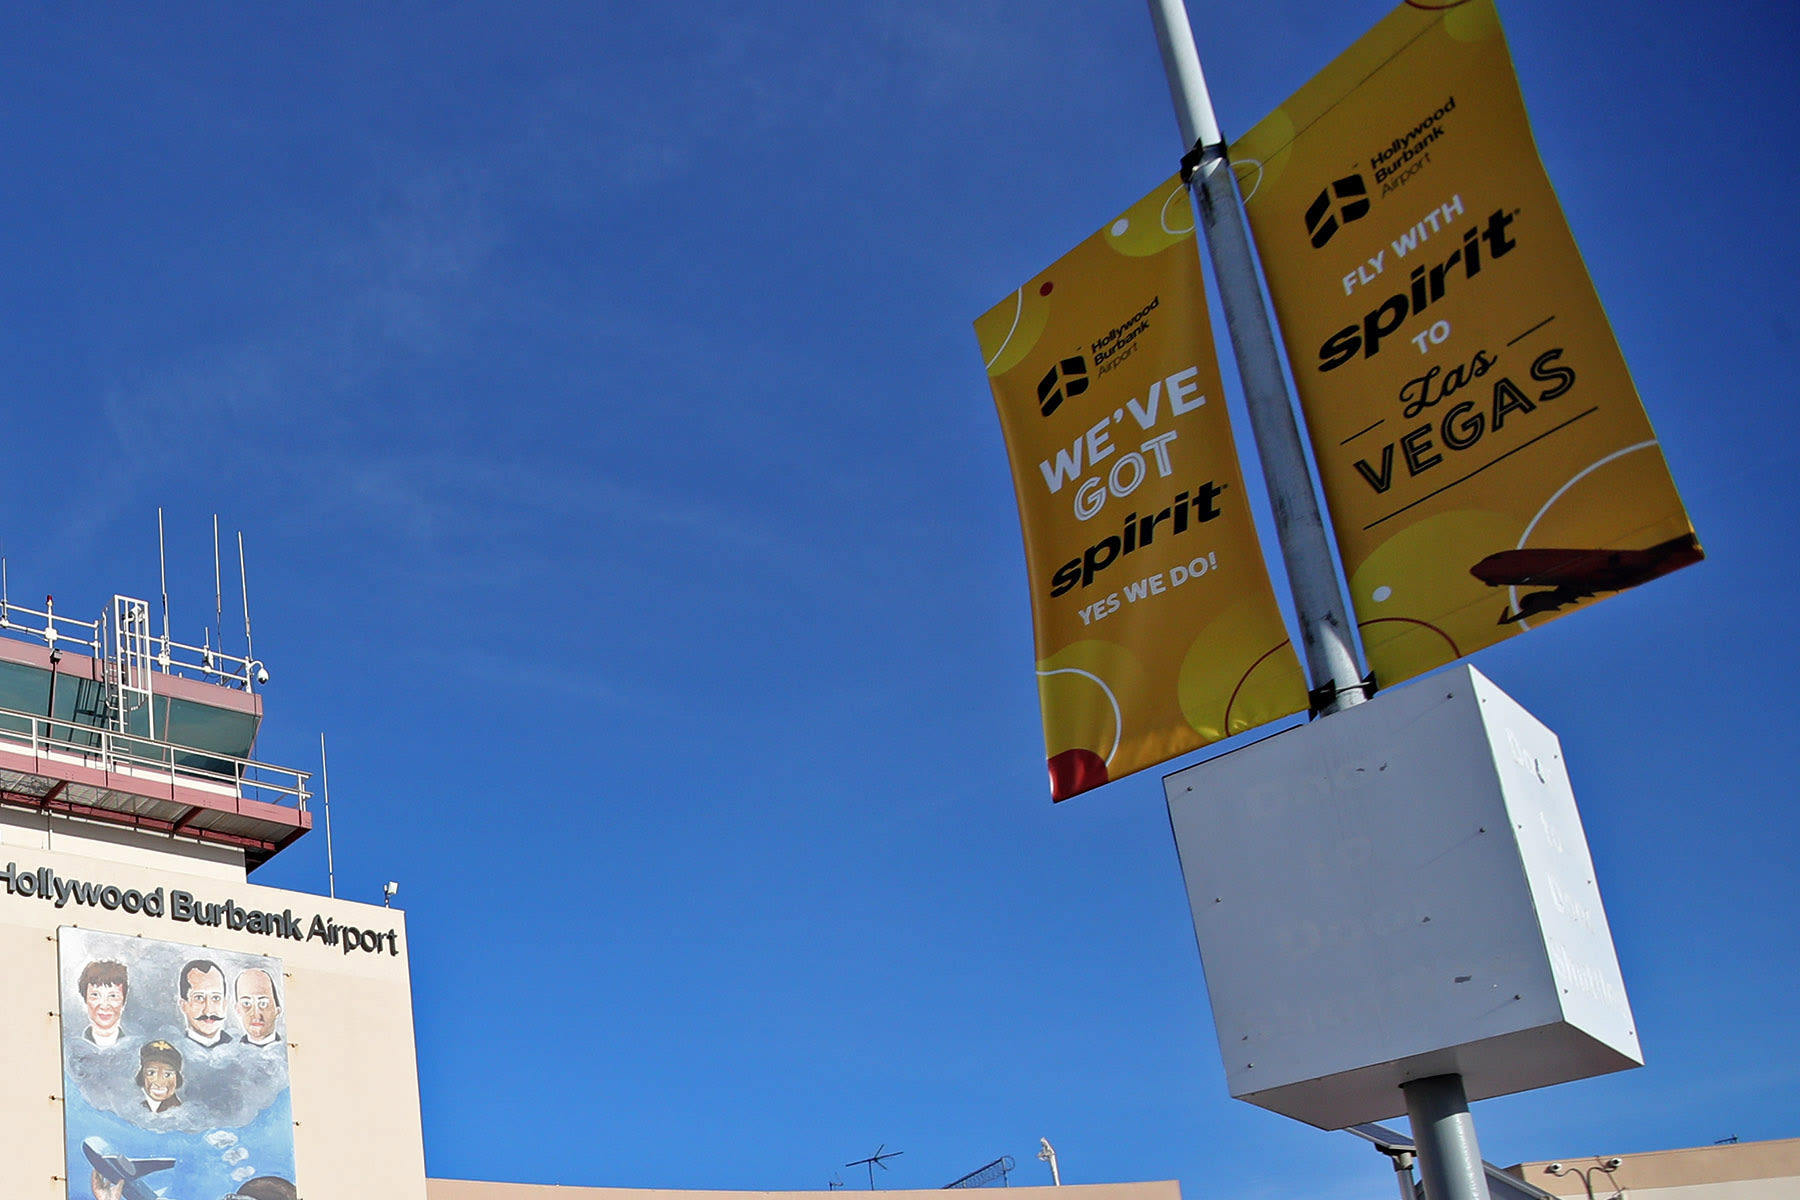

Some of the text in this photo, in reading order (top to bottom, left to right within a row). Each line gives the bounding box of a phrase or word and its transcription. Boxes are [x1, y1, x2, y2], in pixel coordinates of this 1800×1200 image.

[1370, 97, 1457, 170] Hollywood
[1374, 126, 1446, 186] Burbank
[1381, 151, 1432, 200] Airport
[1342, 195, 1465, 297] FLY WITH
[1090, 296, 1160, 354] Hollywood
[1317, 209, 1516, 373] spirit
[1094, 319, 1150, 368] Burbank
[1097, 342, 1139, 380] Airport
[1412, 321, 1451, 354] TO
[1400, 351, 1498, 420] Las
[1354, 348, 1577, 494] VEGAS
[1074, 430, 1178, 521] GOT
[1050, 482, 1224, 598] spirit
[1078, 552, 1218, 627] YES WE DO!
[170, 890, 303, 940] Burbank
[306, 914, 399, 957] Airport
